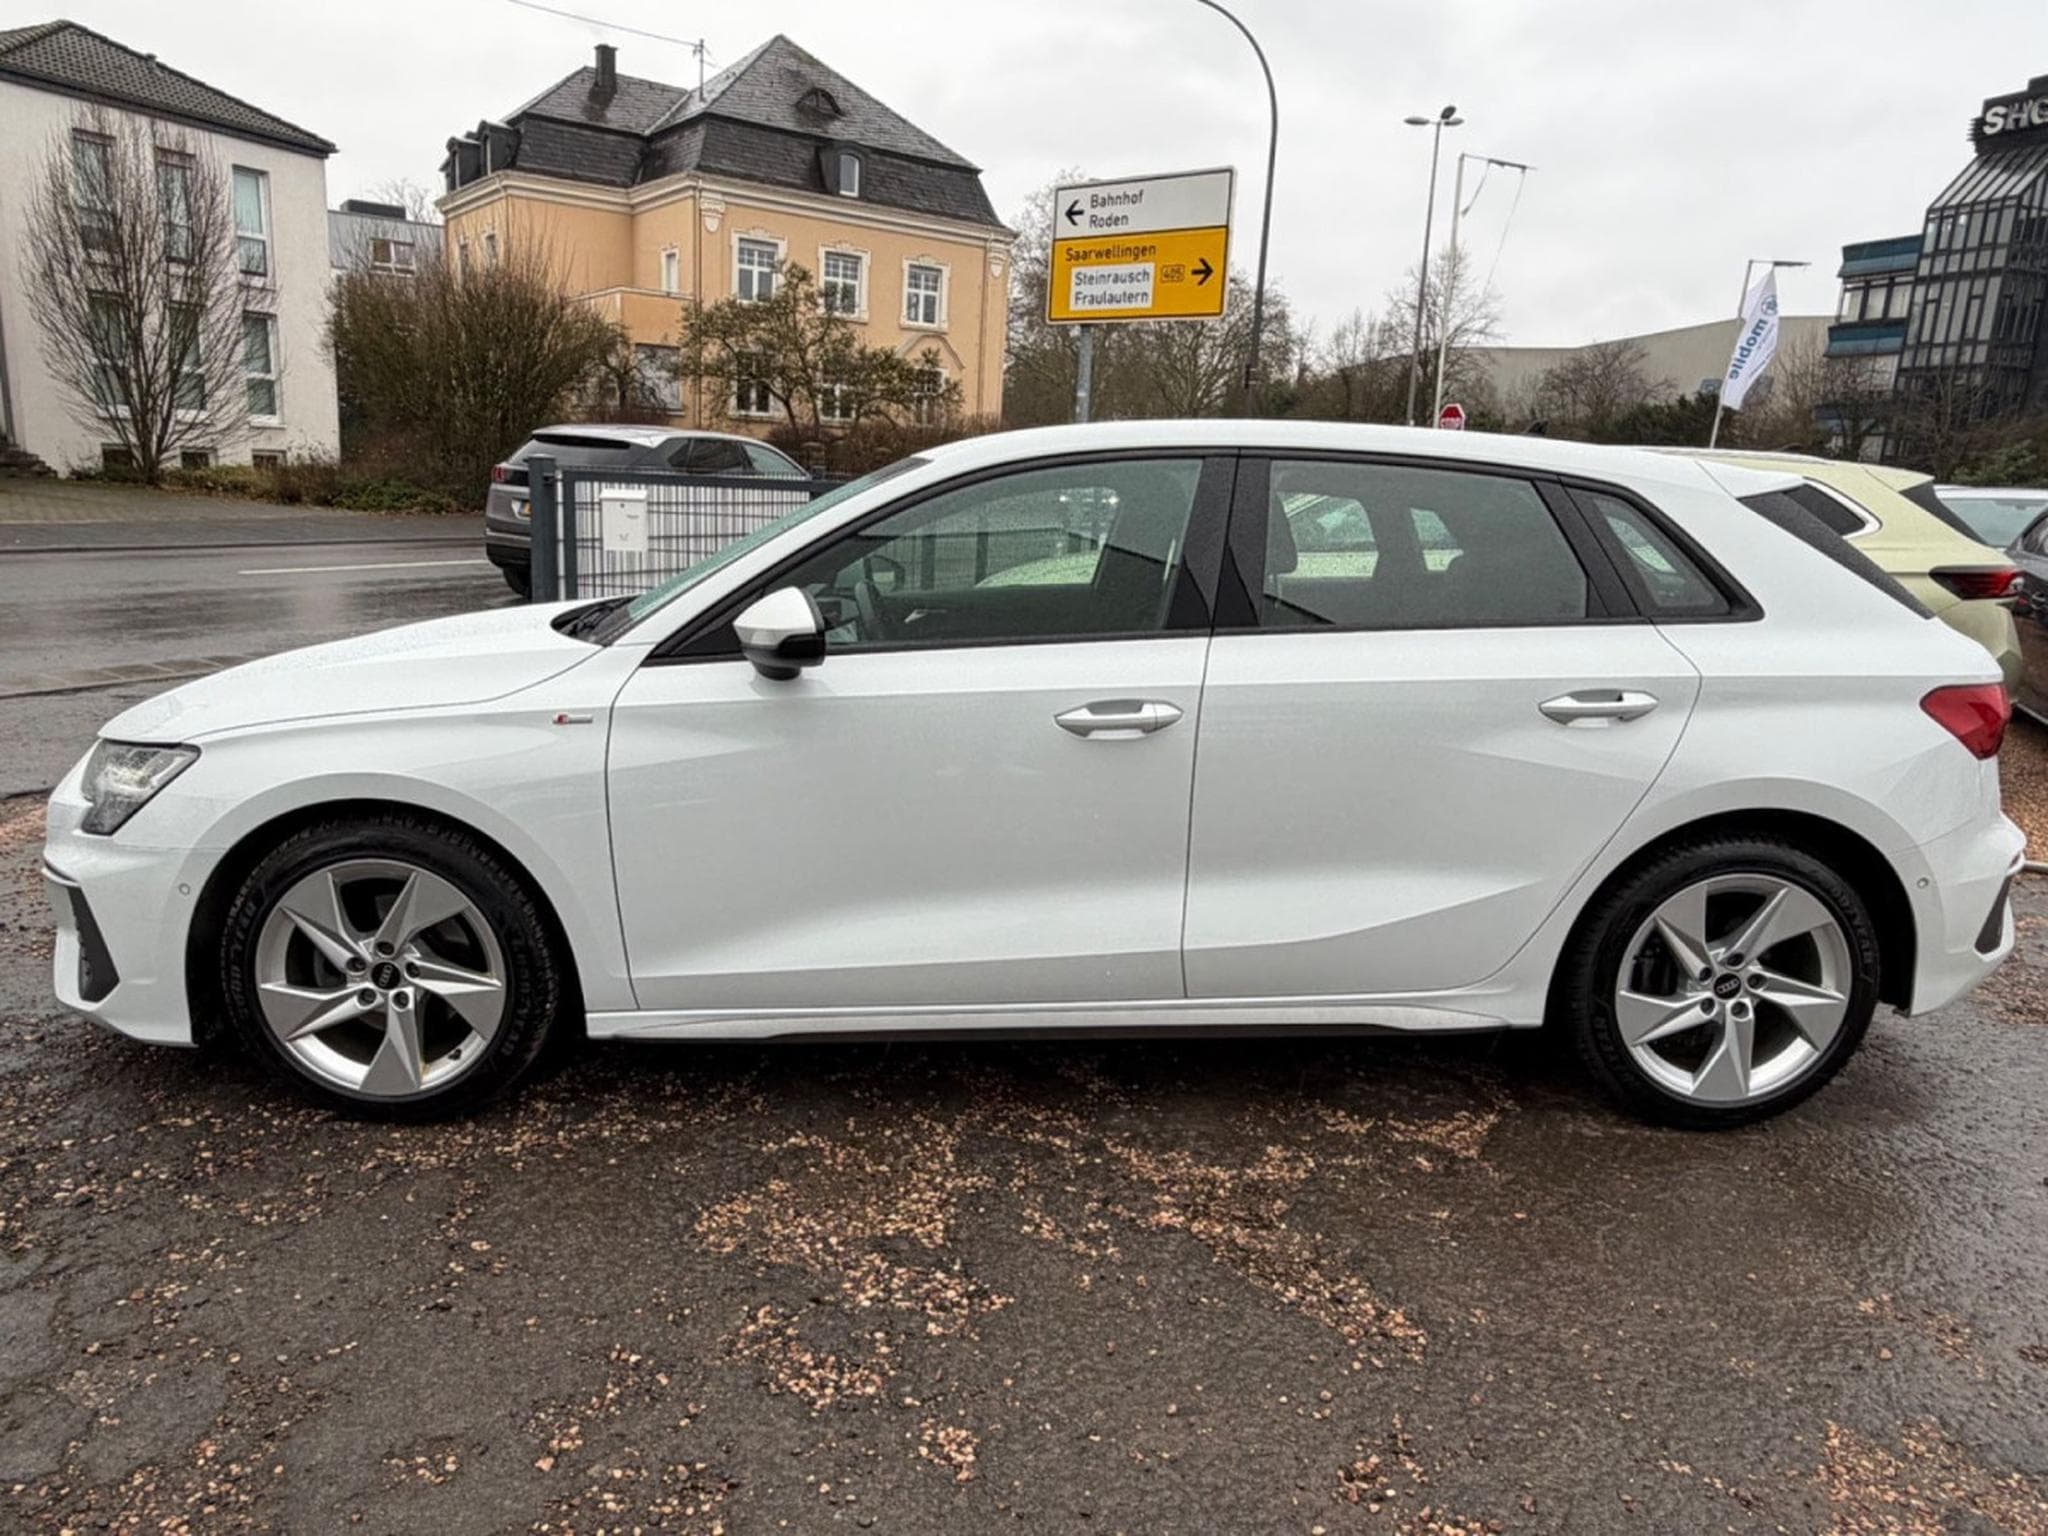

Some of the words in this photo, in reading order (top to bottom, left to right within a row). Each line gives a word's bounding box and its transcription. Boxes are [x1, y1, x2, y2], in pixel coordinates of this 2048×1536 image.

[1090, 189, 1144, 209] Bahnhof
[1089, 213, 1129, 228] Roden
[1065, 244, 1157, 262] Saarwellingen
[1074, 269, 1150, 287] Steinrausch
[1074, 288, 1149, 306] Fraulautern
